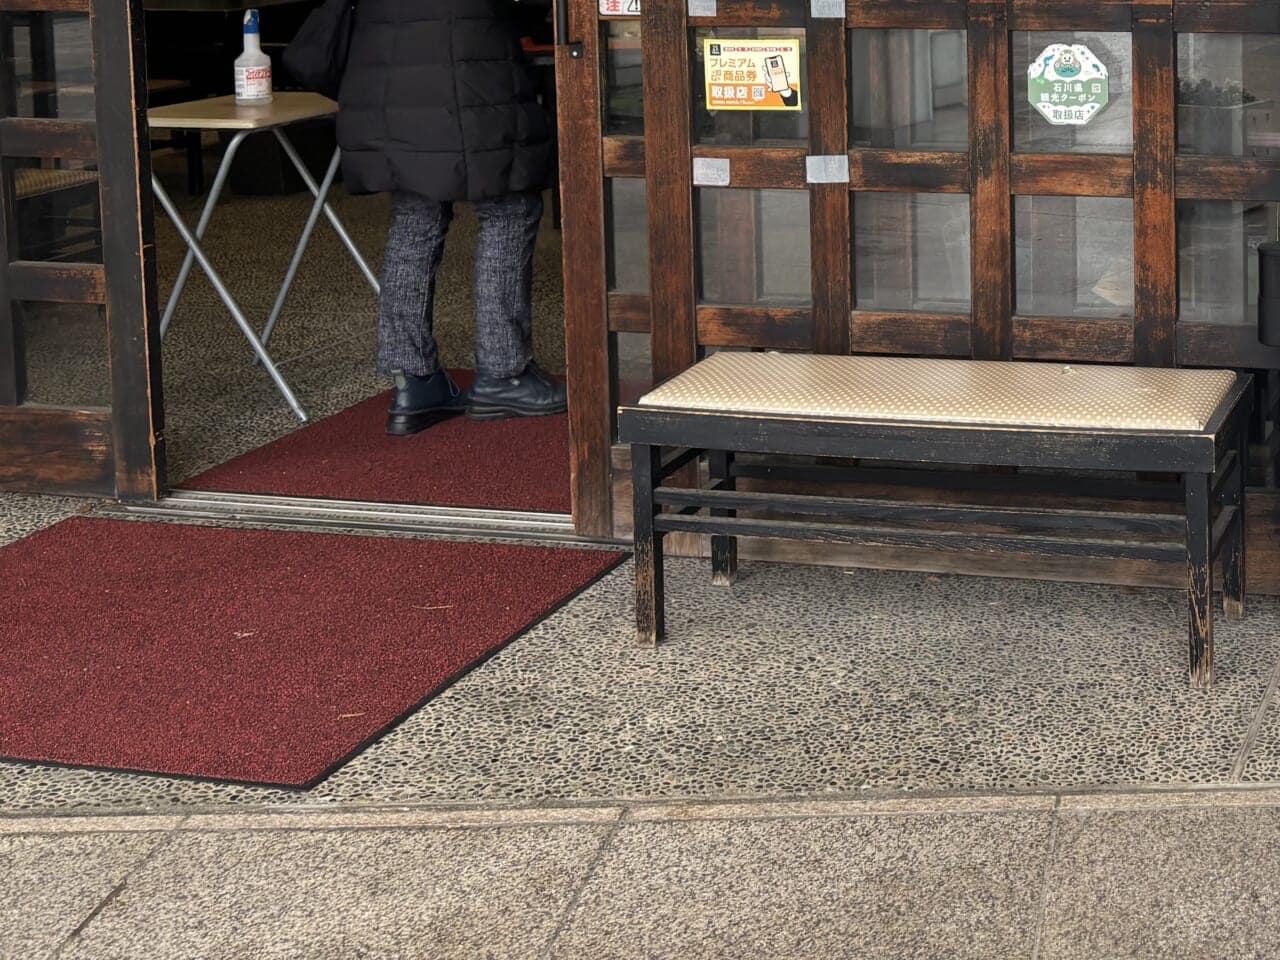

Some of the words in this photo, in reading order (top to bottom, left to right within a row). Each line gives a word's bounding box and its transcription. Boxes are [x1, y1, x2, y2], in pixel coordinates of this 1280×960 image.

[710, 58, 756, 69] プレミアム
[723, 70, 757, 82] 商品券
[711, 85, 749, 99] 取扱店
[1053, 109, 1085, 120] 取扱店
